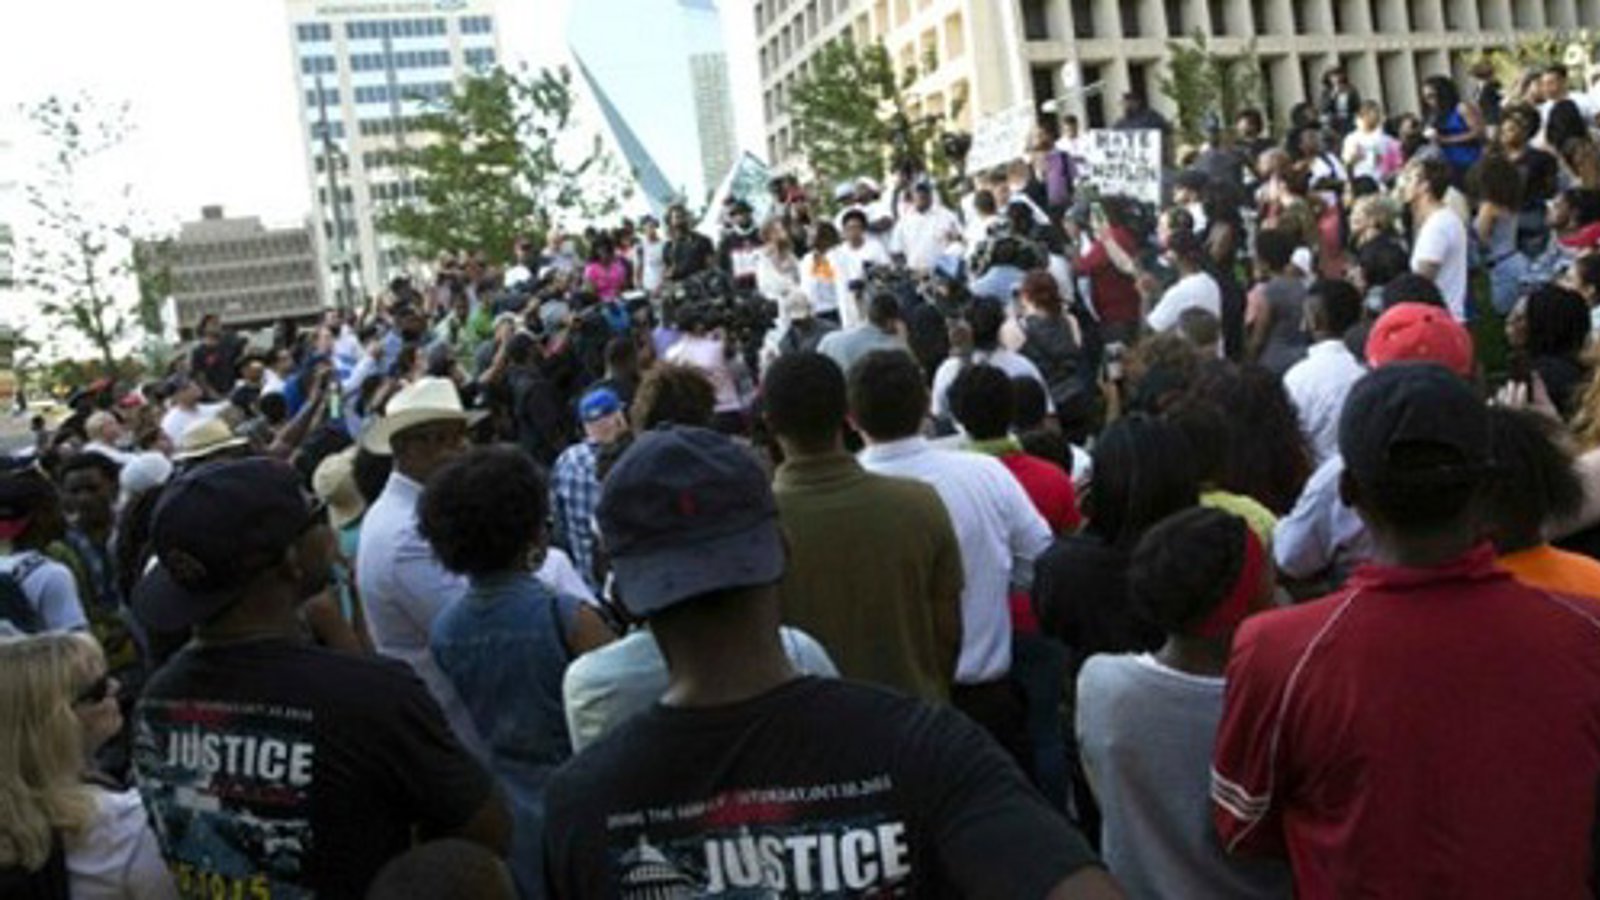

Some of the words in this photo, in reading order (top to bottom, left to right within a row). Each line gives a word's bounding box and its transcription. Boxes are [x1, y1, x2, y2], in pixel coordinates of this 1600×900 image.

[1096, 132, 1152, 149] HATE
[165, 725, 315, 786] JUSTICE
[703, 822, 911, 893] JUSTICE
